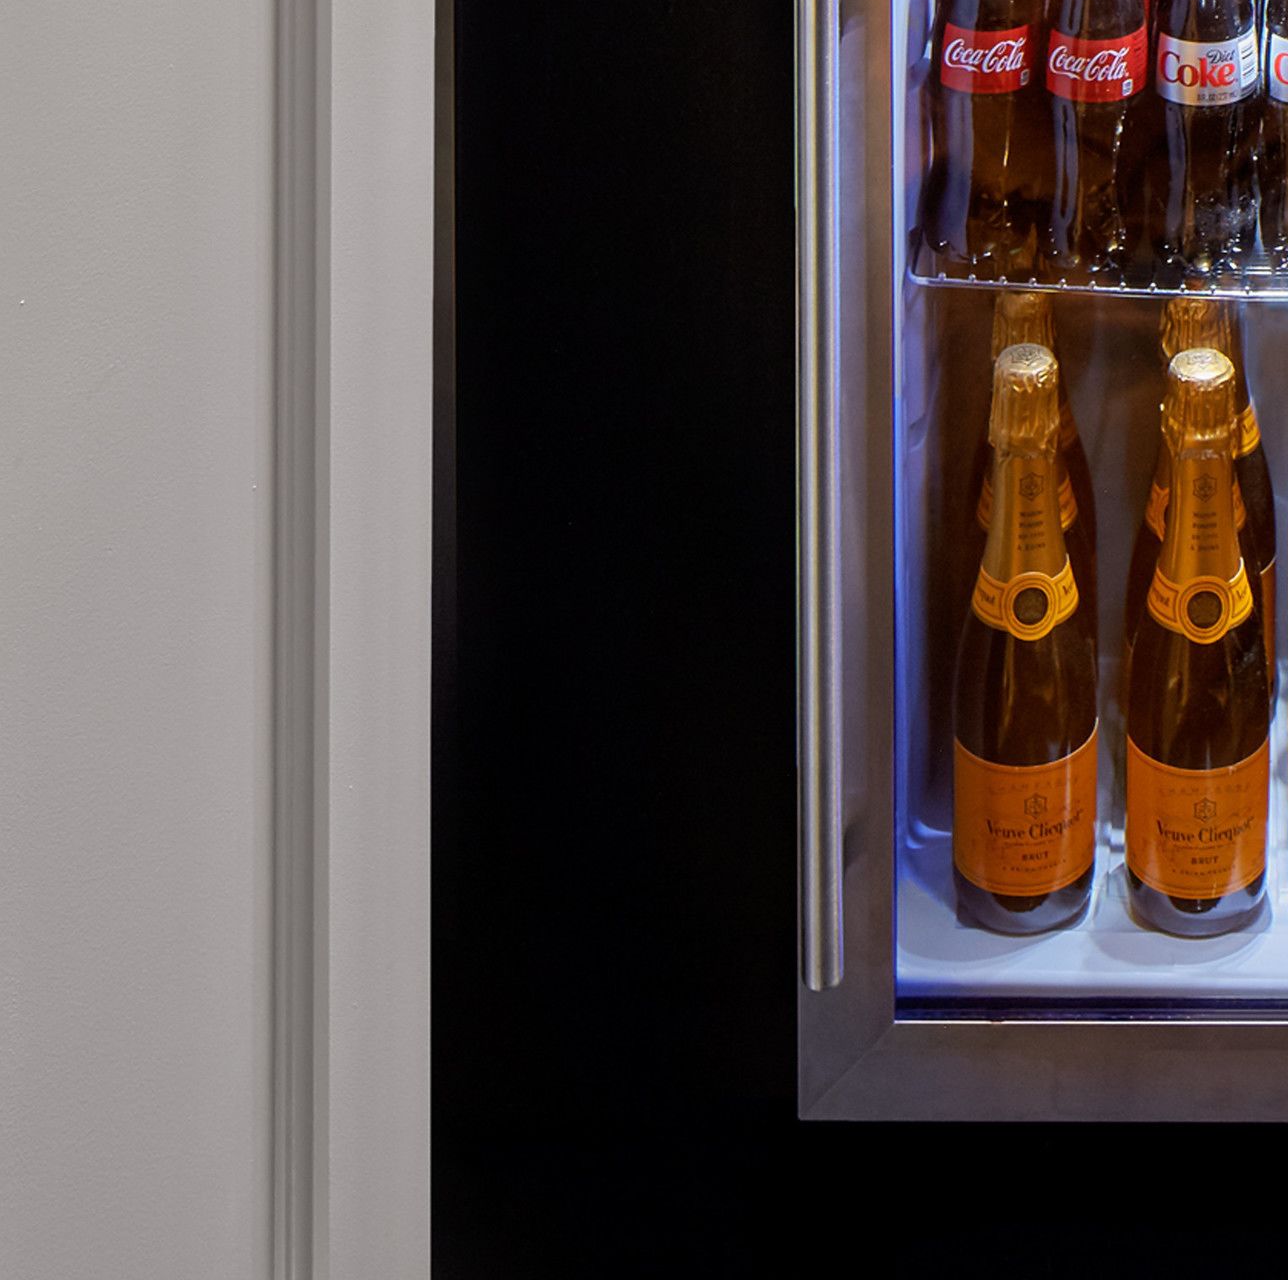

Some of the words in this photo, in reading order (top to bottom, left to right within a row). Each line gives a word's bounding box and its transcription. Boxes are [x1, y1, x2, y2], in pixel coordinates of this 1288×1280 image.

[944, 37, 1026, 73] Coca-Cola
[1049, 46, 1129, 81] Coca-Cola
[1207, 49, 1235, 64] Diet
[1160, 51, 1236, 88] Coke
[986, 819, 1025, 838] Veuve
[1029, 810, 1081, 839] Clicquot
[1157, 819, 1195, 842] Veuve
[1198, 818, 1252, 842] Clicquot
[1022, 851, 1048, 861] BRUT
[1191, 856, 1219, 865] BRUT
